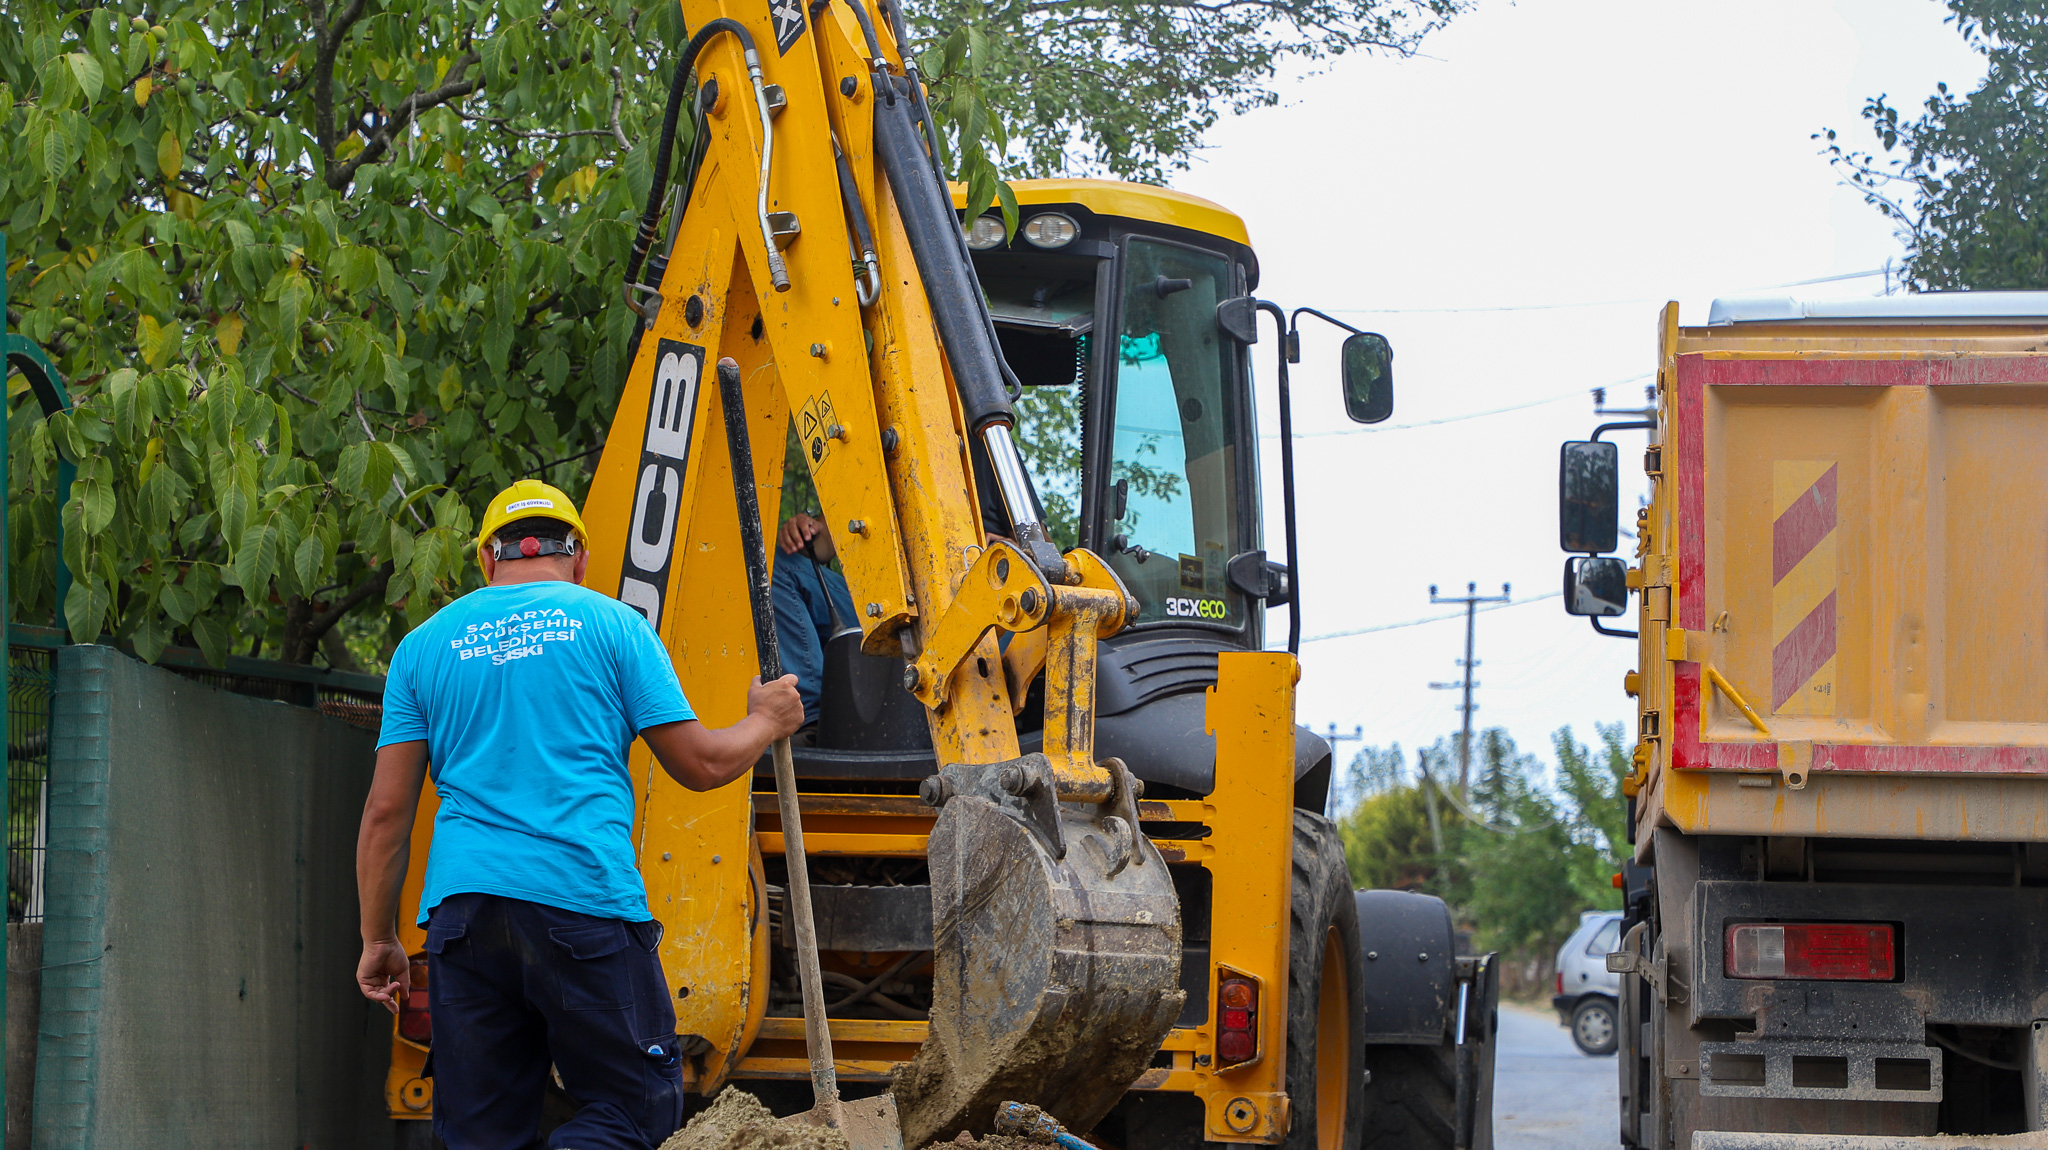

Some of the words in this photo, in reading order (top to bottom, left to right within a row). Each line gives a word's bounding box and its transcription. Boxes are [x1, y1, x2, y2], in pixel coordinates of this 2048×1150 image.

[450, 617, 583, 649] BÜYÜKŞEHİR
[466, 608, 566, 633] SAKARYA
[459, 629, 575, 660] BELEDİYESİ
